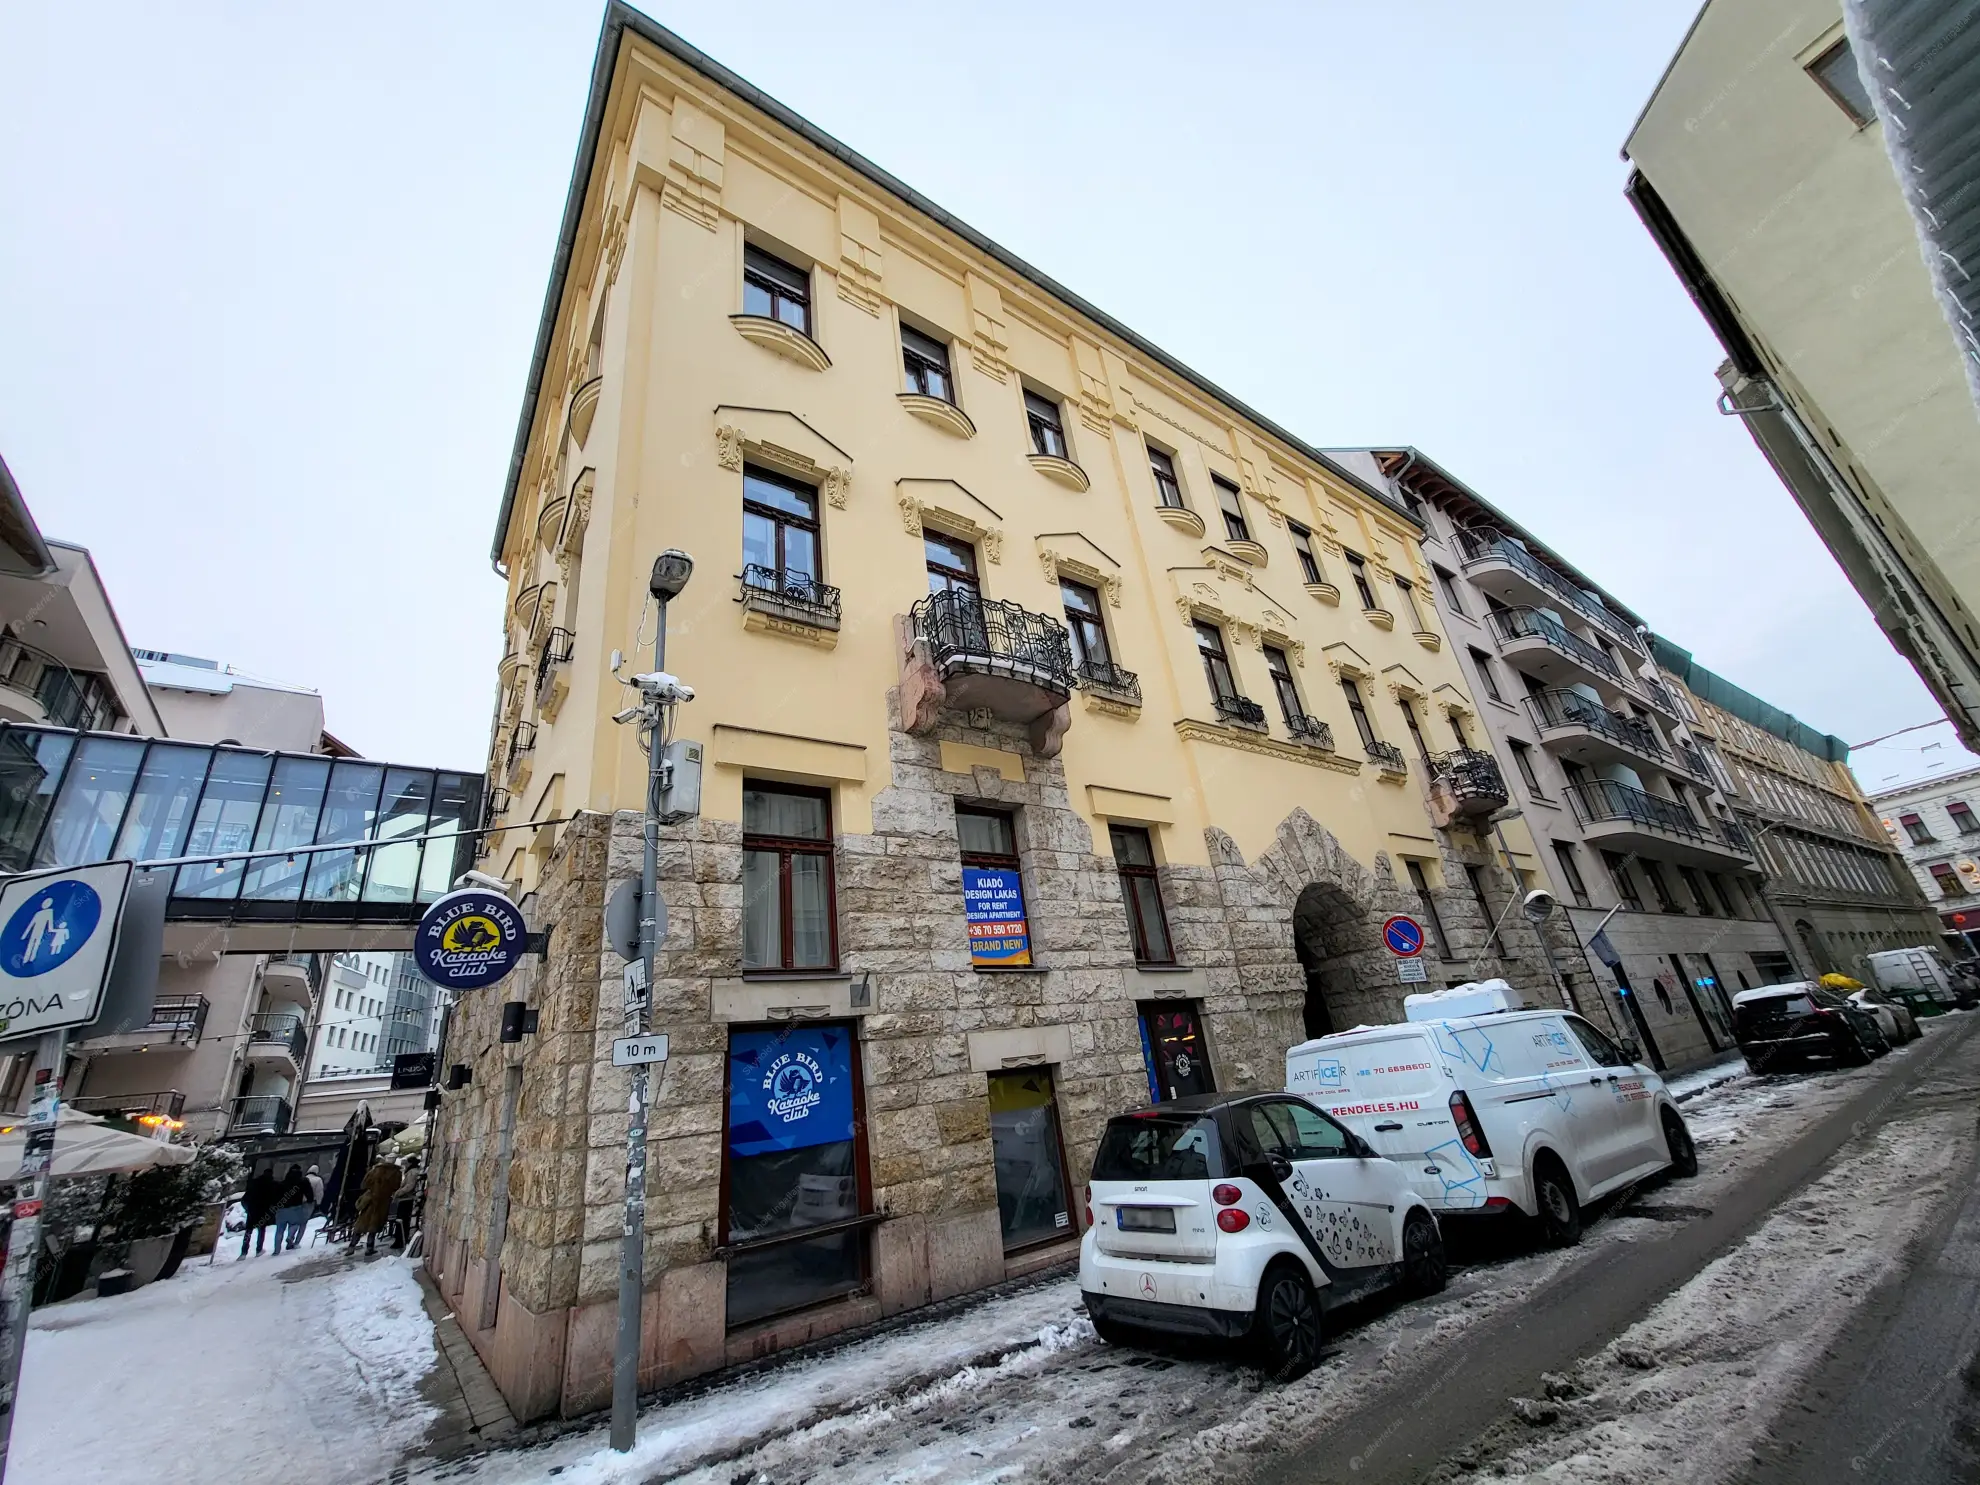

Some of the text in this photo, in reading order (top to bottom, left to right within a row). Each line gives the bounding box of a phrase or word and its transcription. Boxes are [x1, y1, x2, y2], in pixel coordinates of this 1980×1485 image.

[977, 876, 1003, 888] KIADÓ
[965, 888, 1017, 899] DESIGN LAKÁS
[978, 902, 1007, 910] FOR RENT
[428, 903, 516, 940] BLUE BIRD
[966, 911, 1020, 920] DESIGN APARTMENT
[969, 924, 1022, 935] +36 70 550 1720
[972, 939, 1023, 952] BRAND NEW!
[429, 946, 507, 967] Karaoke
[449, 962, 487, 977] club
[626, 1044, 656, 1057] 10 m
[763, 1052, 823, 1090] BLUE BIRD
[1293, 1066, 1347, 1081] ARTIFICER
[1388, 1062, 1431, 1072] 6698600
[767, 1090, 820, 1115] Karaoke
[783, 1105, 809, 1122] club
